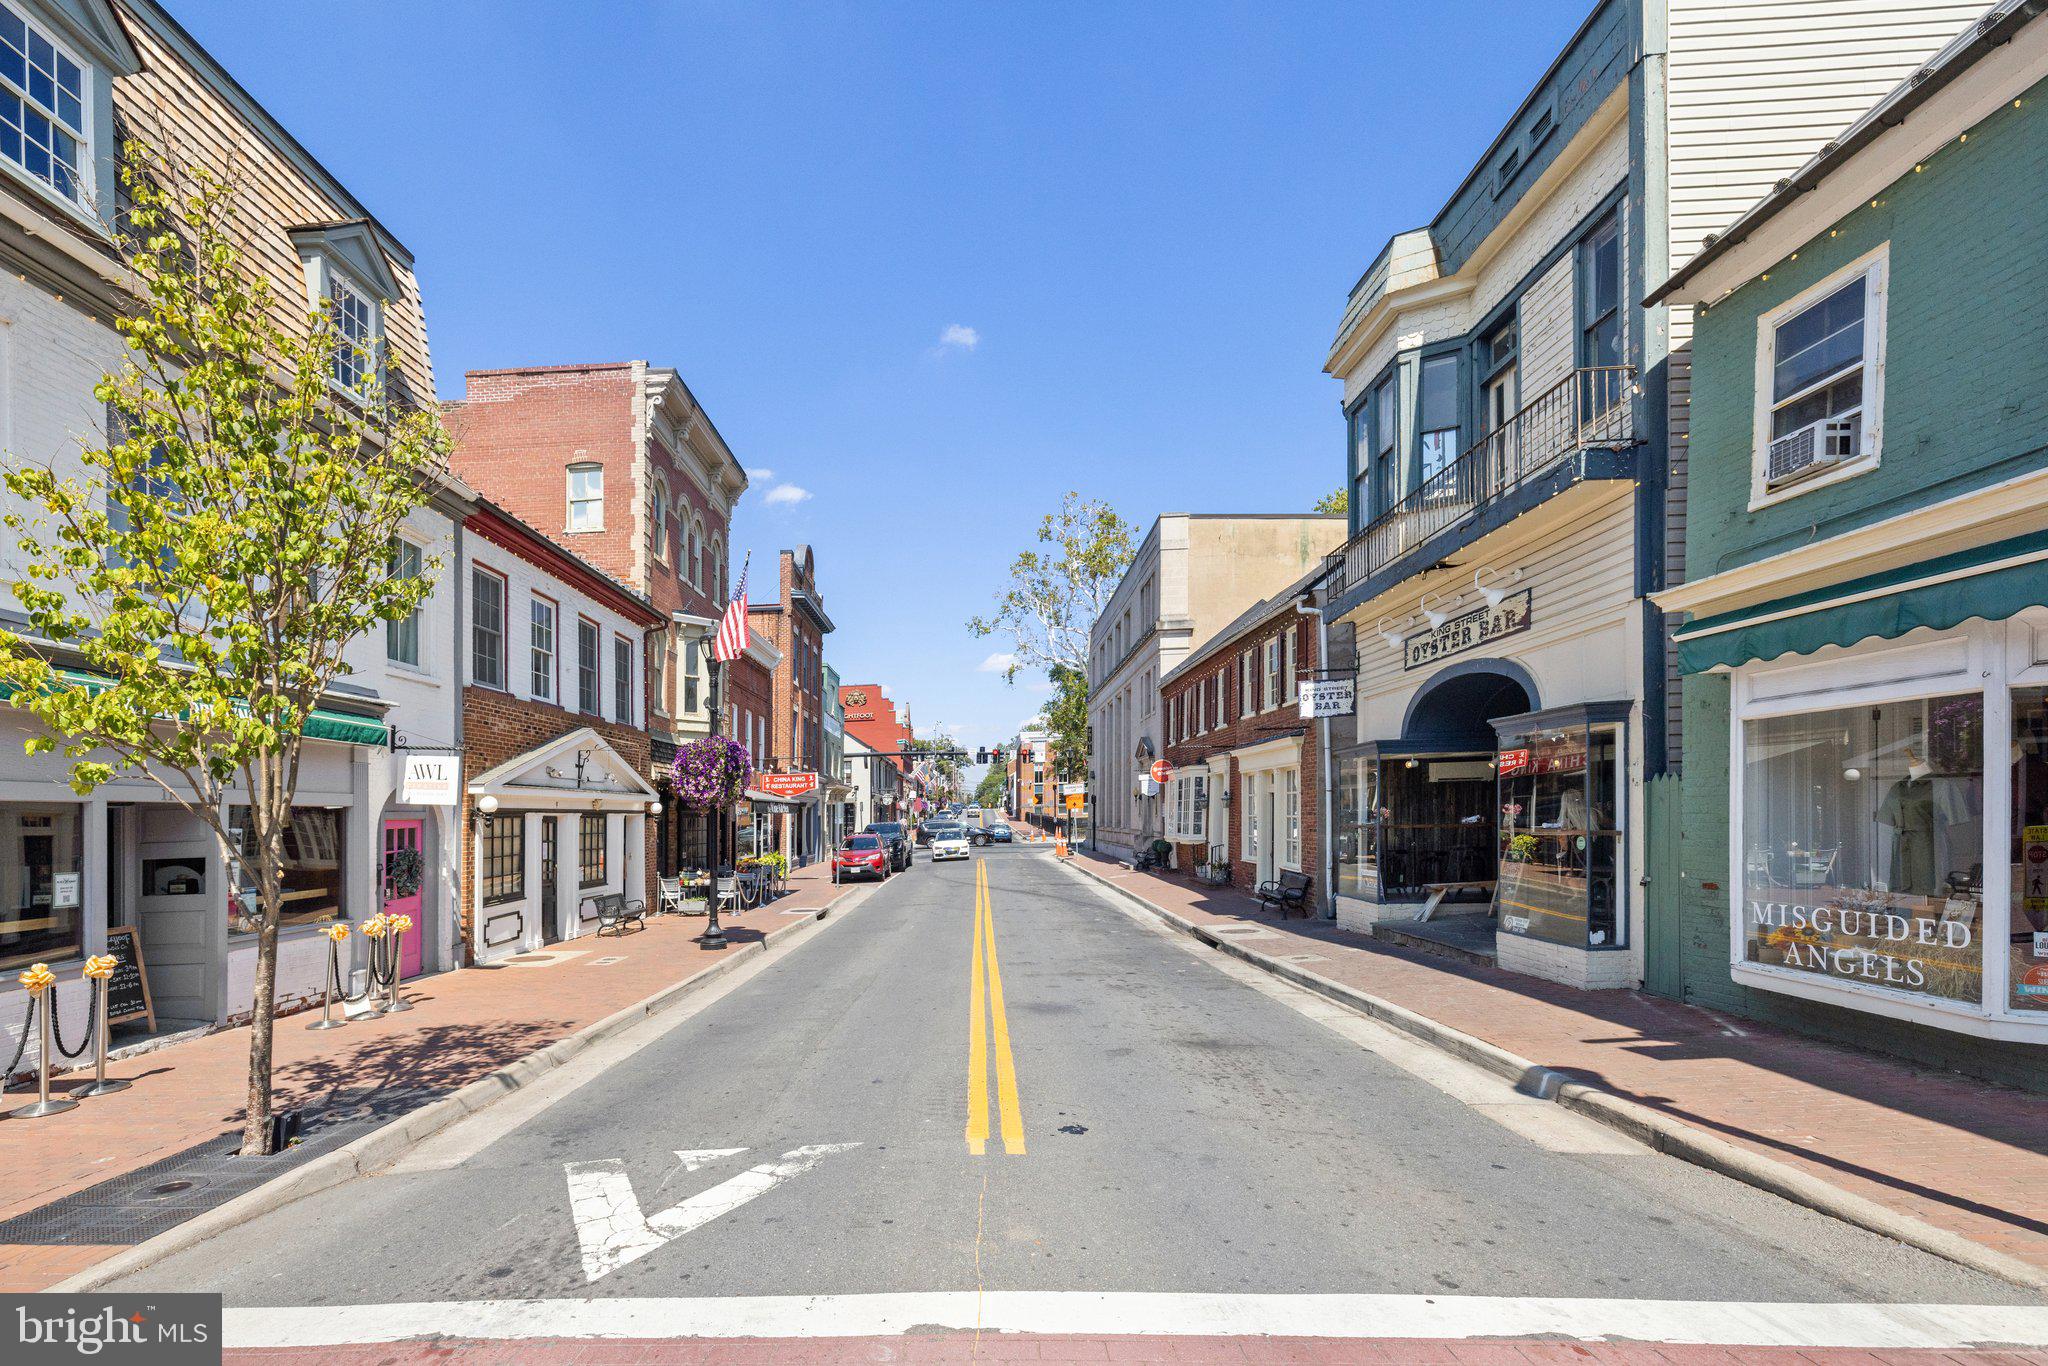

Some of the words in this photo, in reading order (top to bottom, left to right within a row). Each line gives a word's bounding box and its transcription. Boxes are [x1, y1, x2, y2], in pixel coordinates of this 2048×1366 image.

[1412, 627, 1472, 662] OYSTER
[1479, 609, 1518, 639] BAR
[1430, 625, 1451, 639] KING
[1454, 609, 1491, 630] STREET
[1302, 691, 1352, 701] OYSTER
[1315, 702, 1341, 710] BAR
[408, 763, 448, 781] AWL
[1752, 902, 1972, 948] MISGUIDED
[1784, 942, 1925, 986] ANGELS
